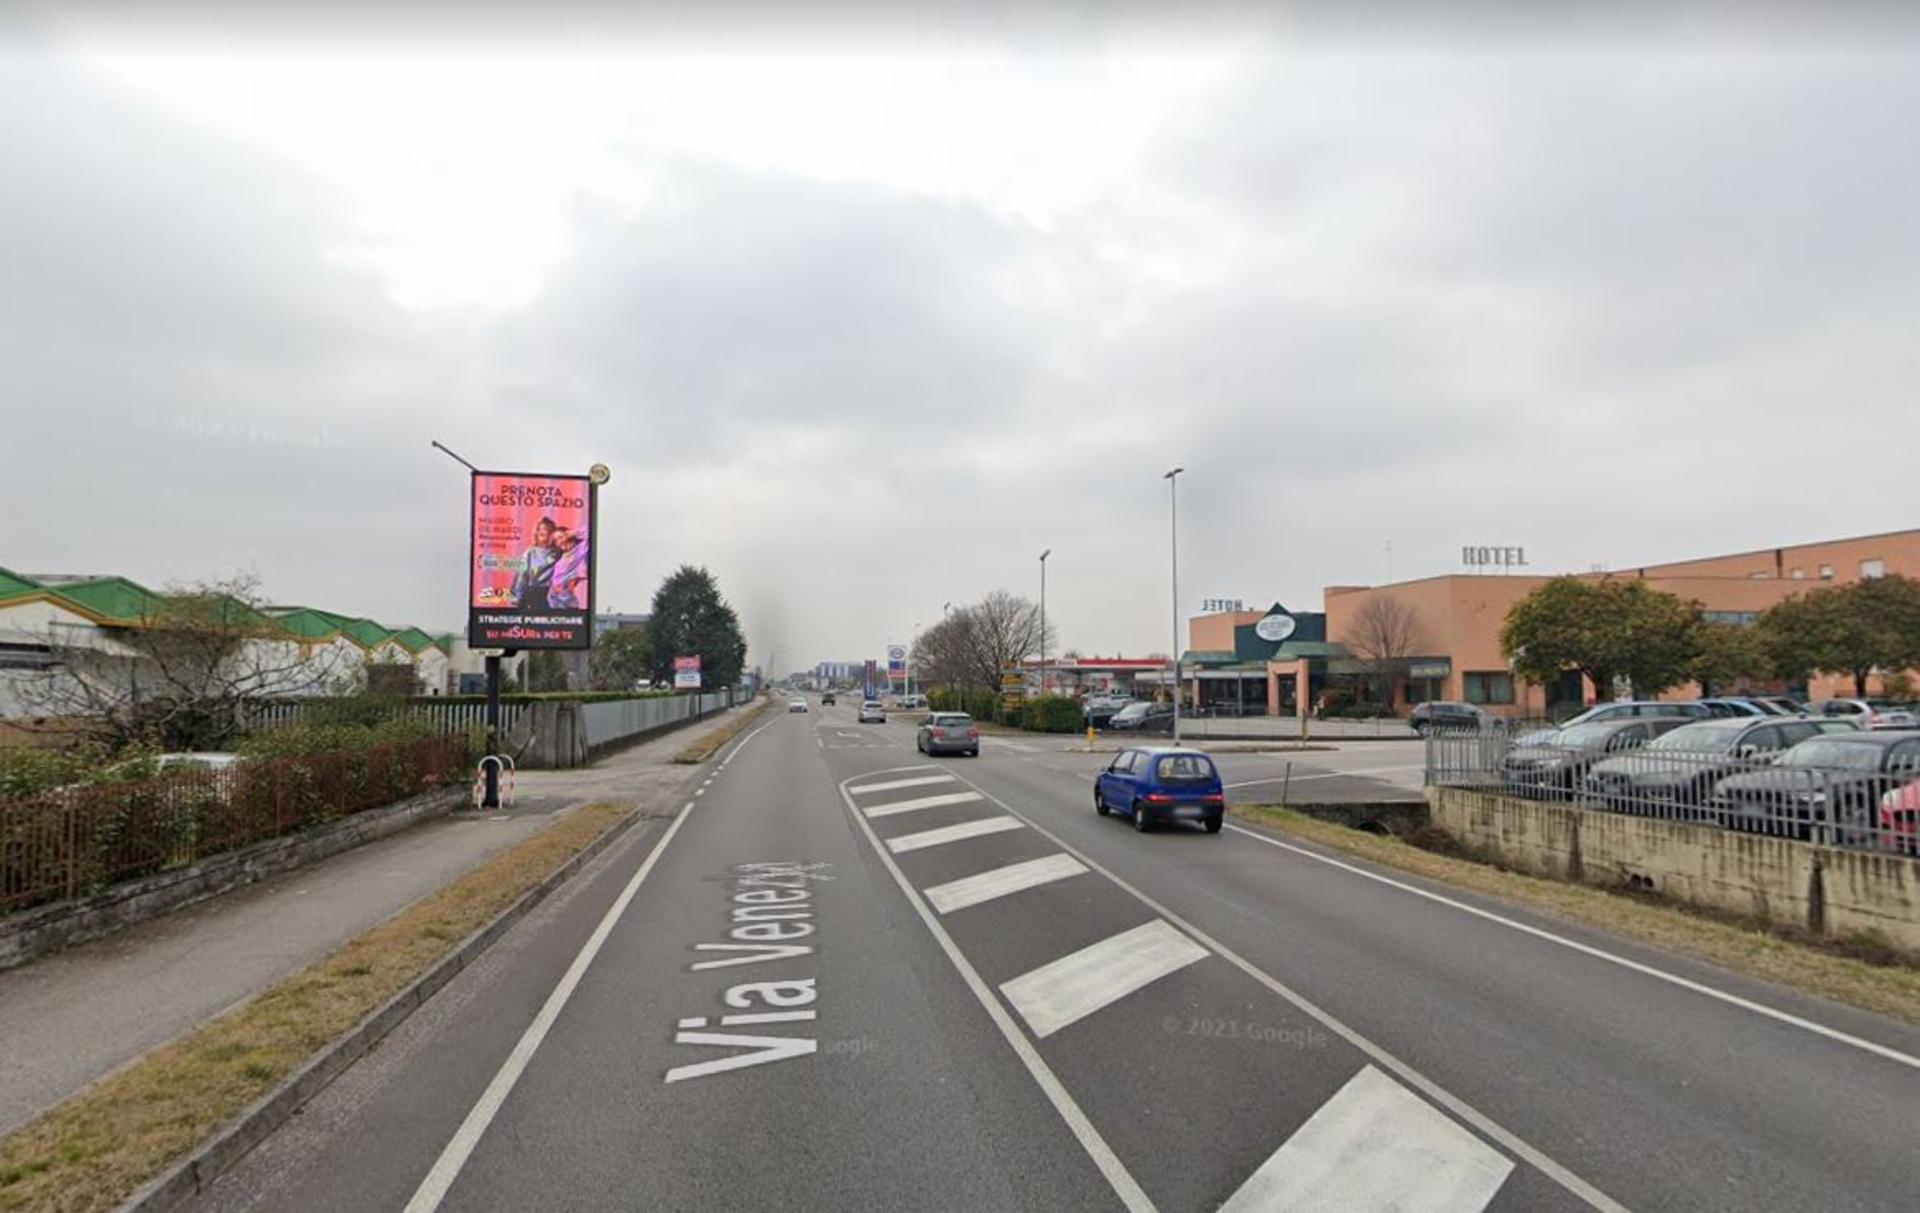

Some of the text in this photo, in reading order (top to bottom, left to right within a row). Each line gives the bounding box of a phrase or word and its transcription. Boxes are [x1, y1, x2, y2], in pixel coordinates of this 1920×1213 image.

[501, 485, 562, 497] PRENOTA
[480, 495, 584, 508] QUESTO SPAZIO
[1462, 546, 1530, 566] HOTEL
[478, 615, 522, 624] STRATEGIE
